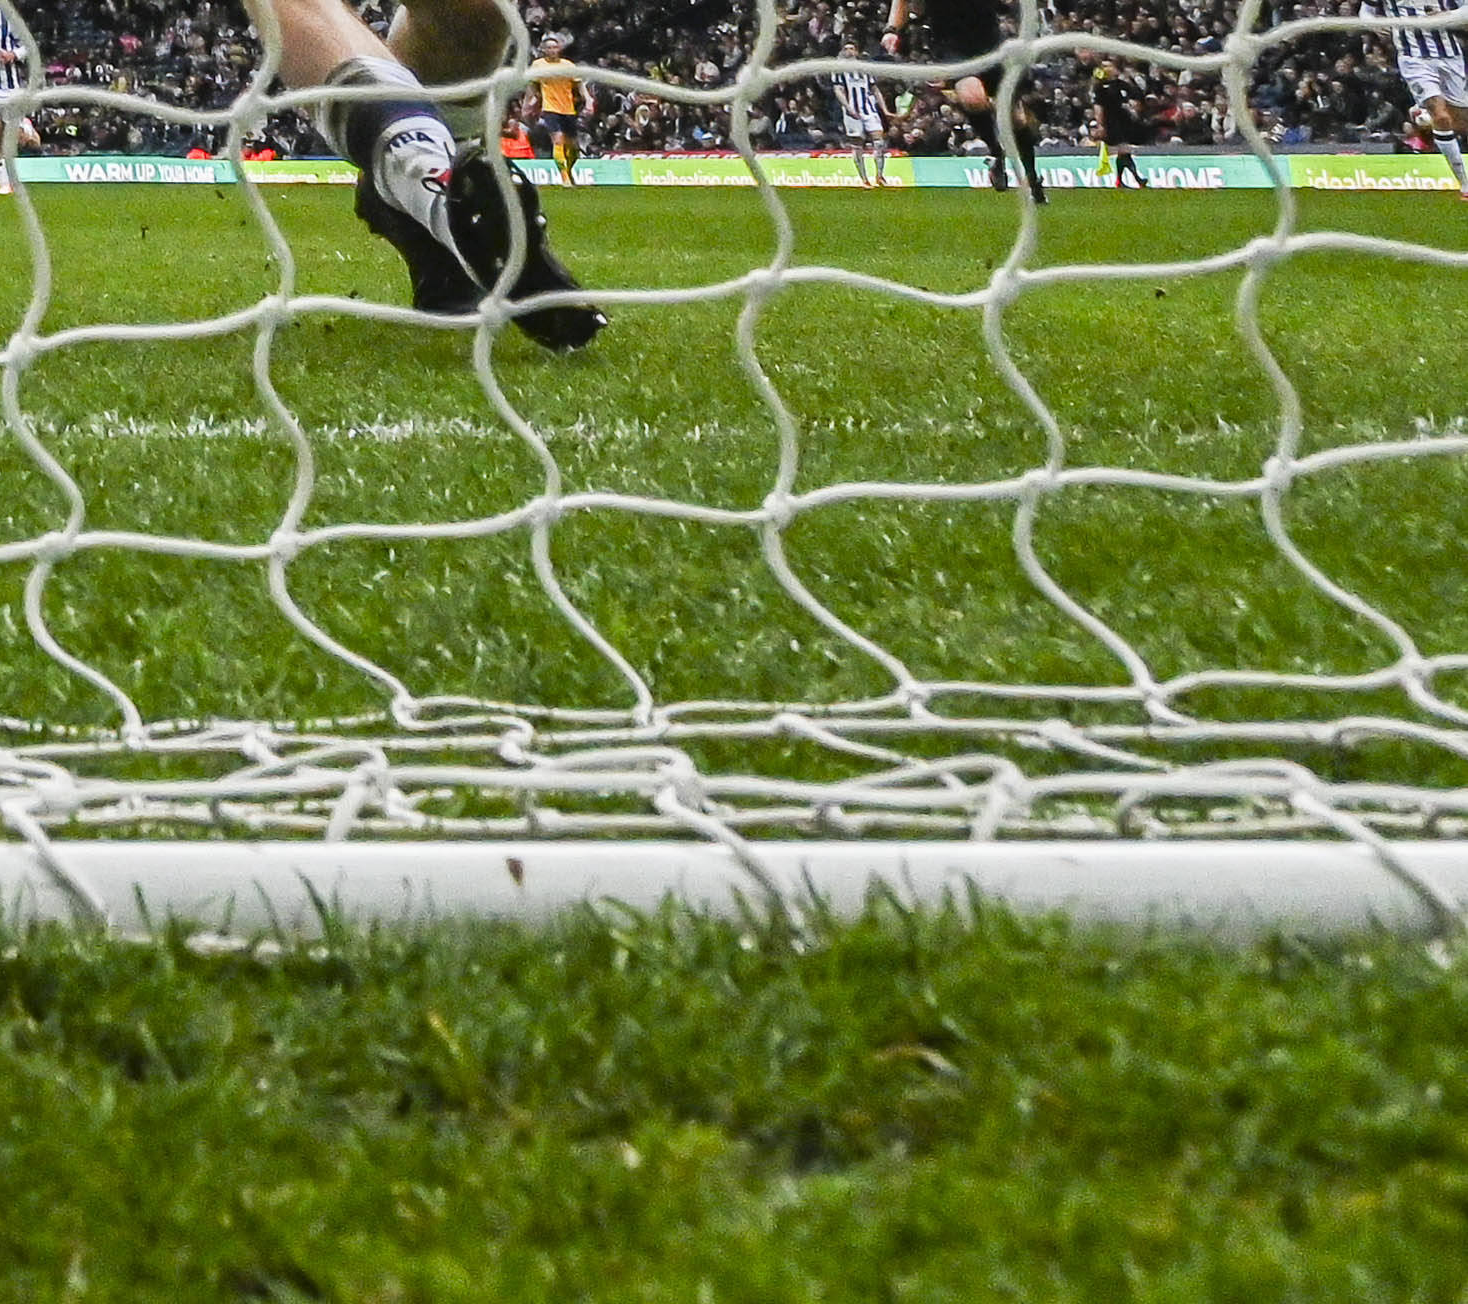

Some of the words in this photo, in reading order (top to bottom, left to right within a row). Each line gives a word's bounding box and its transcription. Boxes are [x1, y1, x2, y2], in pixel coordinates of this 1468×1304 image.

[65, 163, 133, 182] WARM
[135, 163, 155, 182] UP
[1148, 168, 1225, 188] HOME
